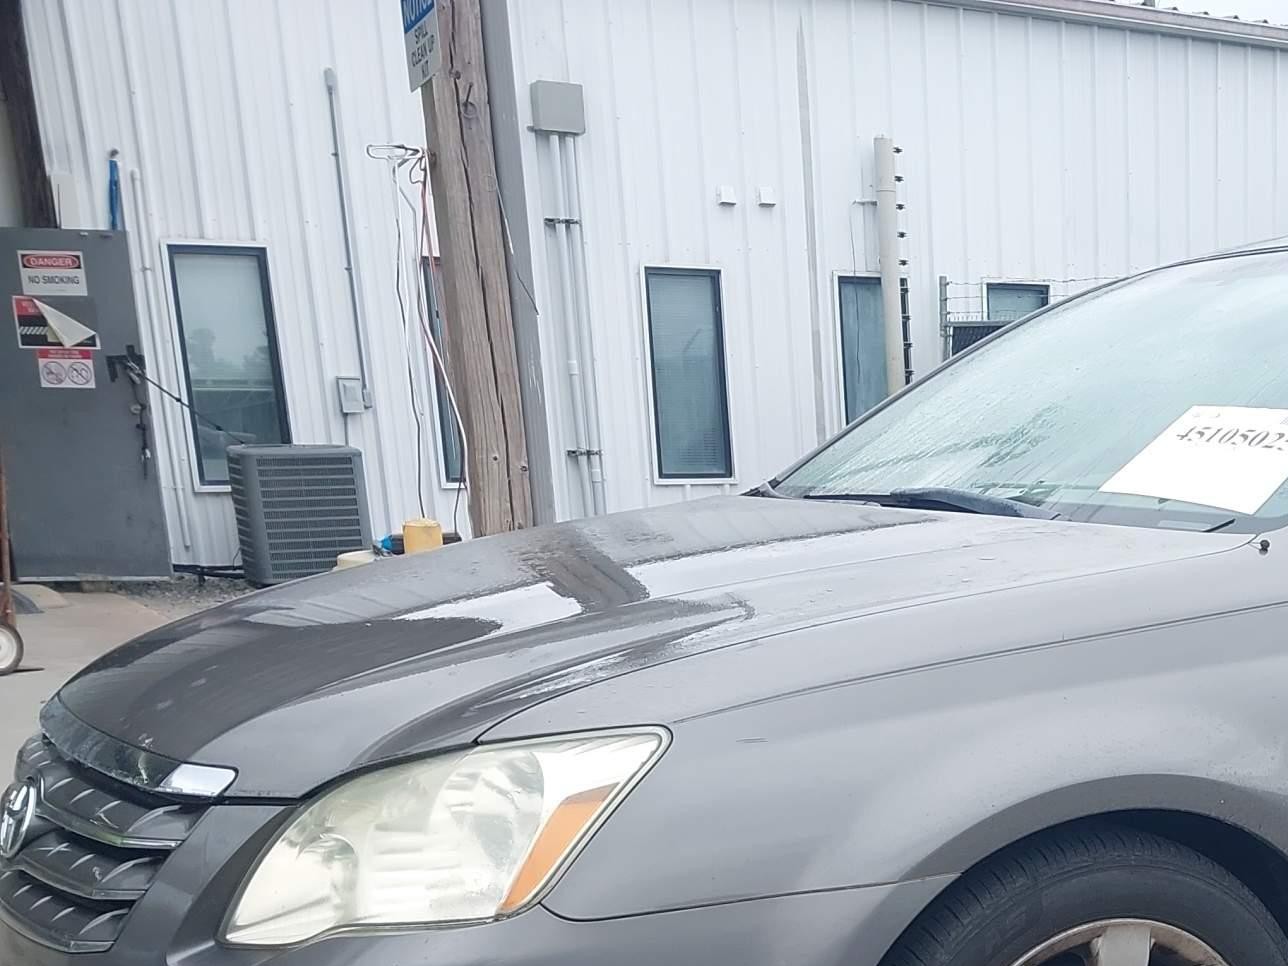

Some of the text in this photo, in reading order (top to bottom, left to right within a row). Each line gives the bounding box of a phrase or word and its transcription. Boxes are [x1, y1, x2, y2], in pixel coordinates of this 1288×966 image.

[414, 20, 429, 44] SPILL
[411, 33, 435, 68] CLEAN UP
[29, 256, 73, 267] DANGER
[28, 275, 80, 285] NO SMOKING
